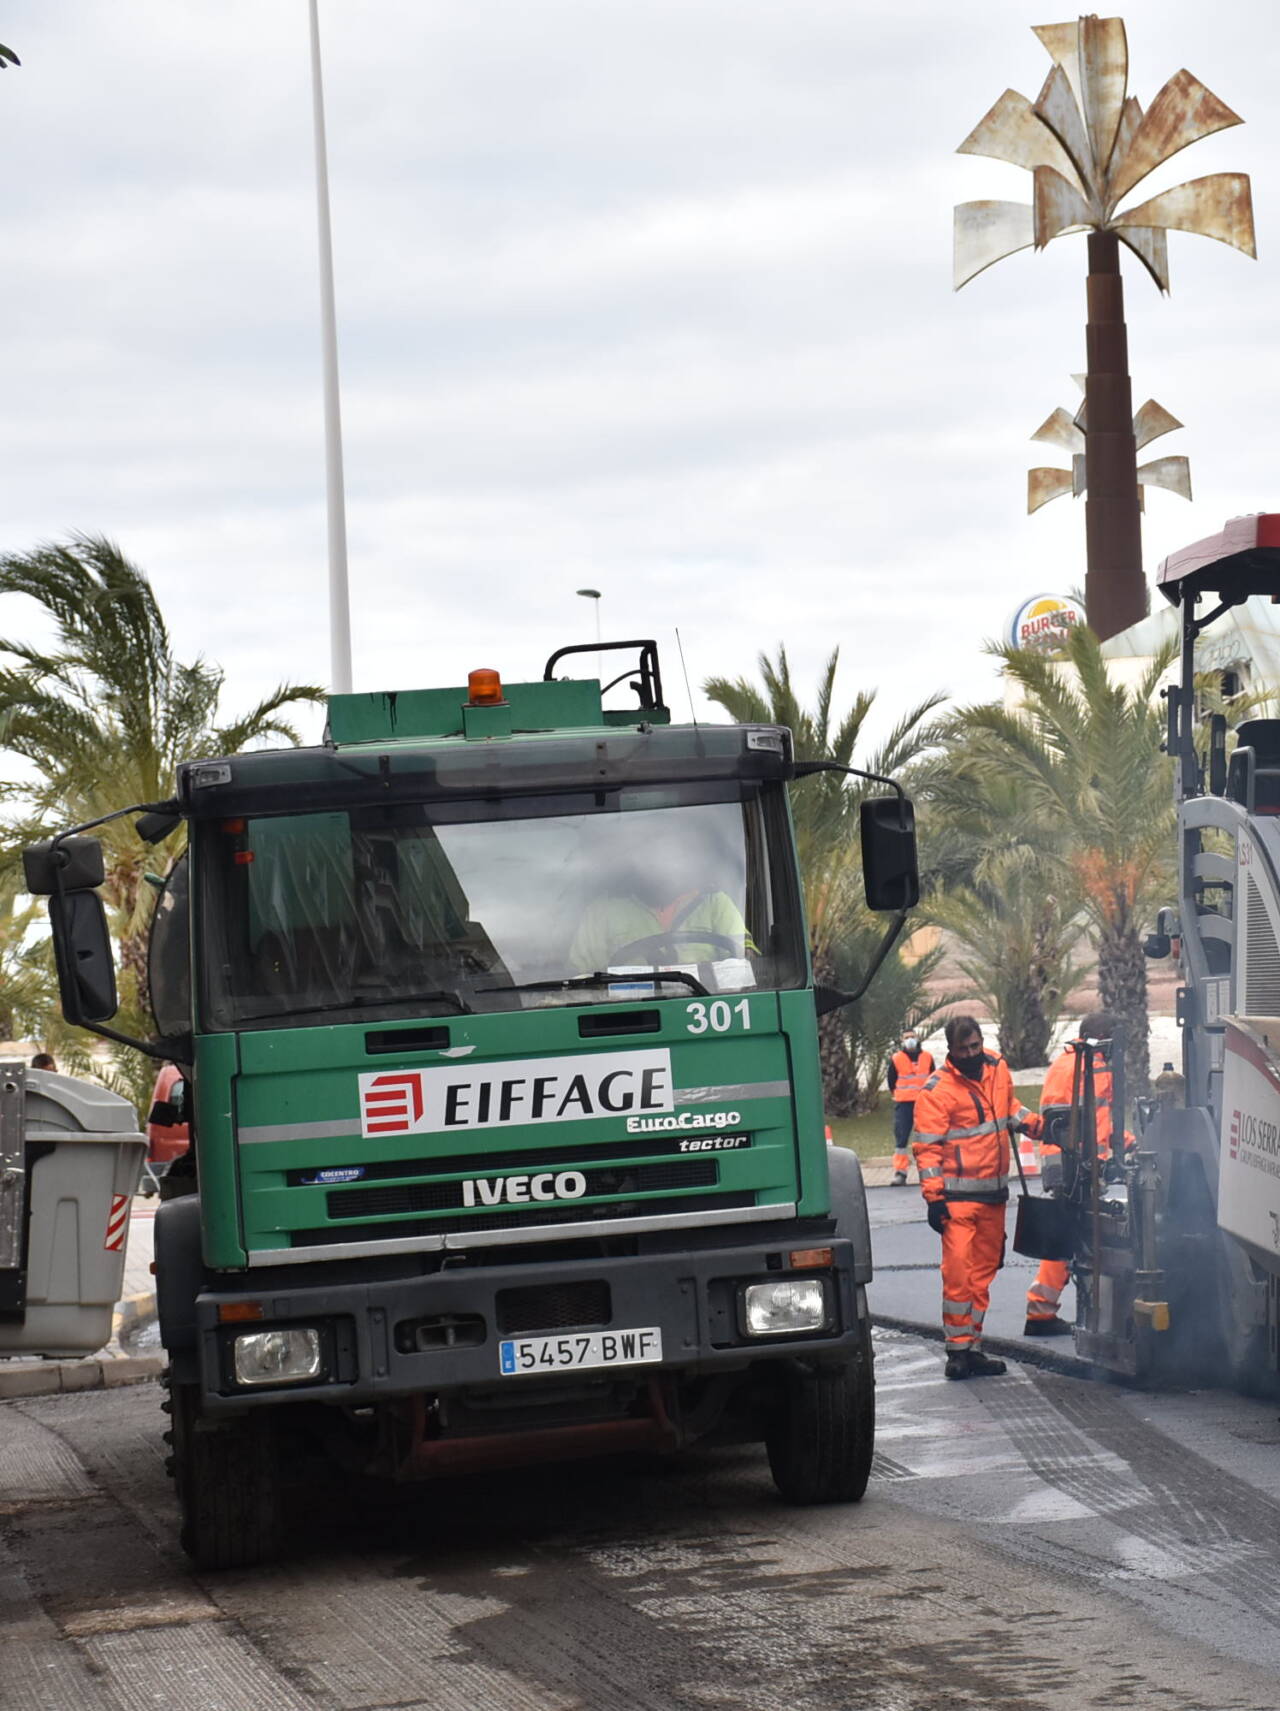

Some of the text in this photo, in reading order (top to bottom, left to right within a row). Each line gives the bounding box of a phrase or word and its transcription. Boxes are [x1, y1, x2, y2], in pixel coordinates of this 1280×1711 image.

[686, 999, 752, 1035] 301
[444, 1067, 667, 1126] EIFFAGE
[626, 1111, 741, 1133] EuroCargo
[1241, 1114, 1257, 1147] LOS
[679, 1136, 747, 1152] tector
[463, 1171, 587, 1207] IVECO
[519, 1338, 591, 1369] 5457
[602, 1332, 654, 1362] BWF
